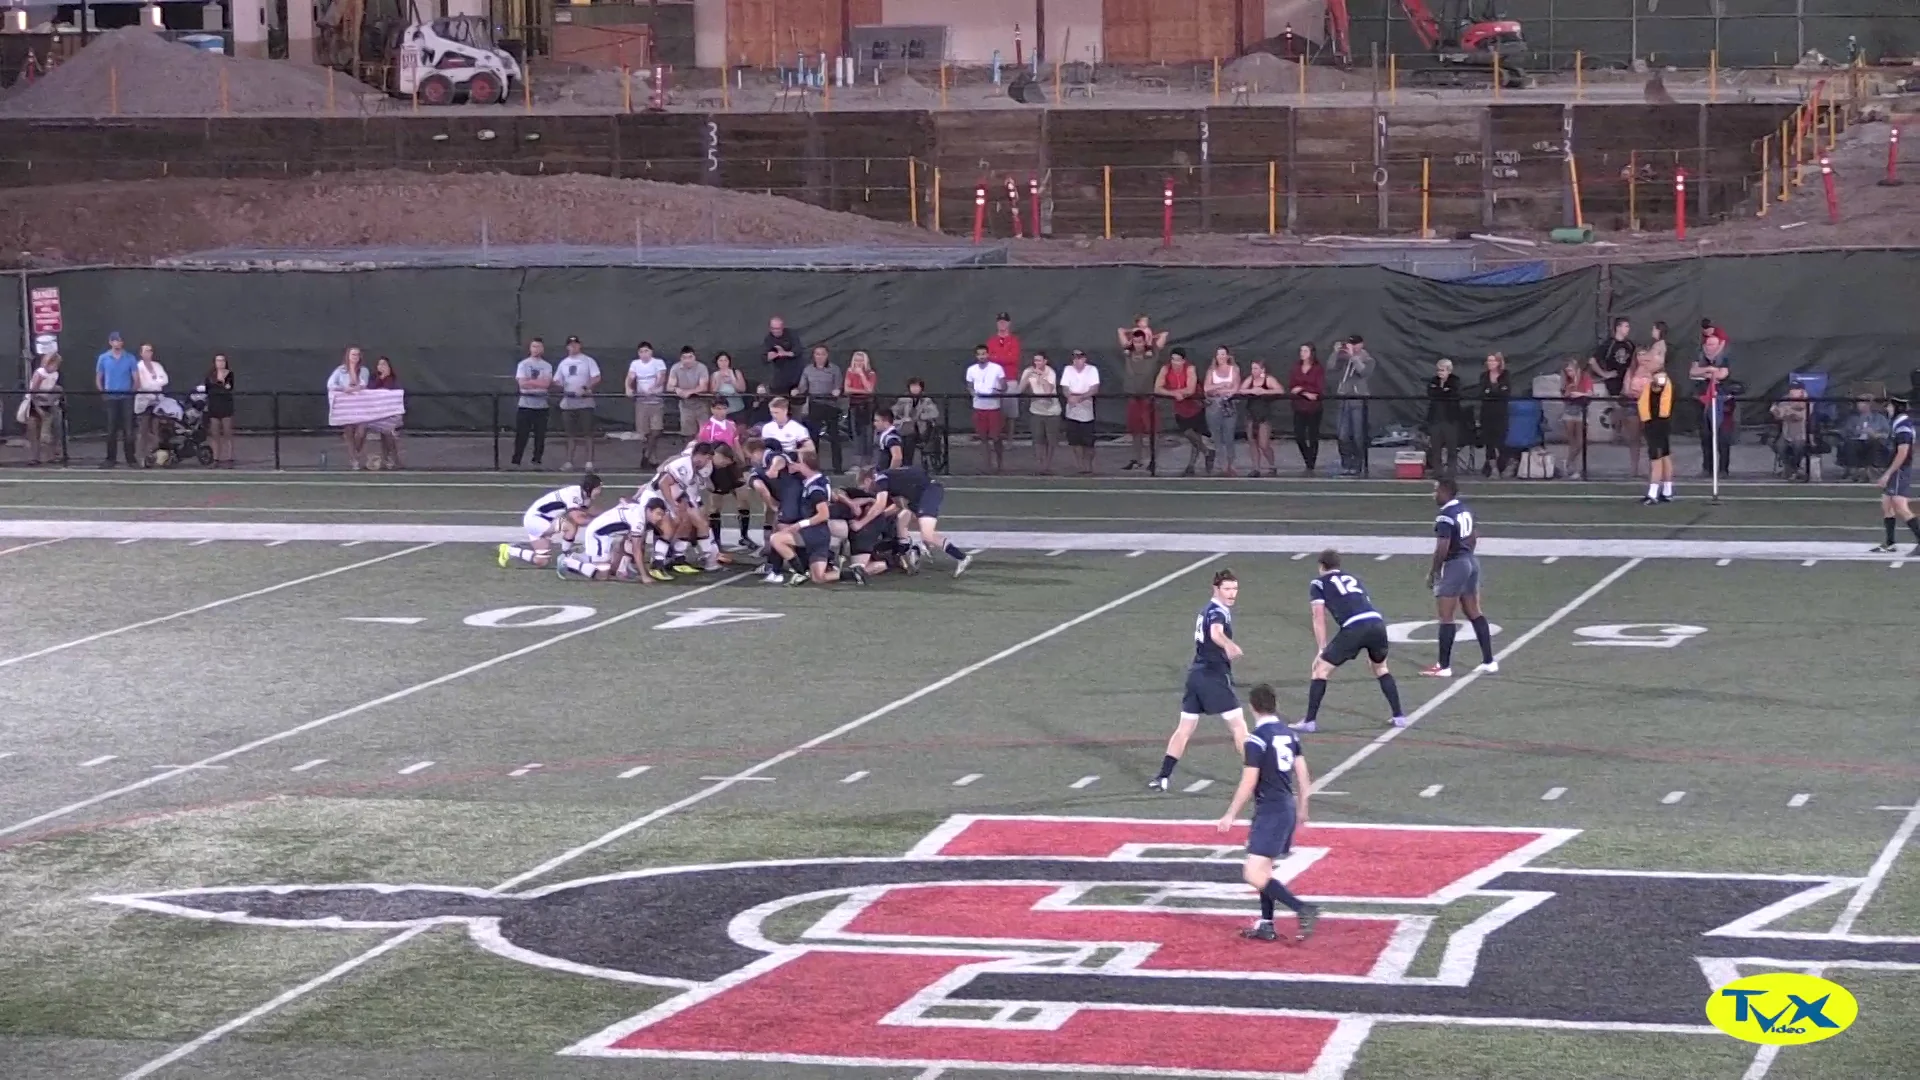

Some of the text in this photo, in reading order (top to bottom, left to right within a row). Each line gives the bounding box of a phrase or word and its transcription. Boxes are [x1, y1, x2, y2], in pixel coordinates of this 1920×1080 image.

[707, 121, 718, 172] 35
[1456, 511, 1473, 538] 10
[1330, 574, 1364, 596] 12
